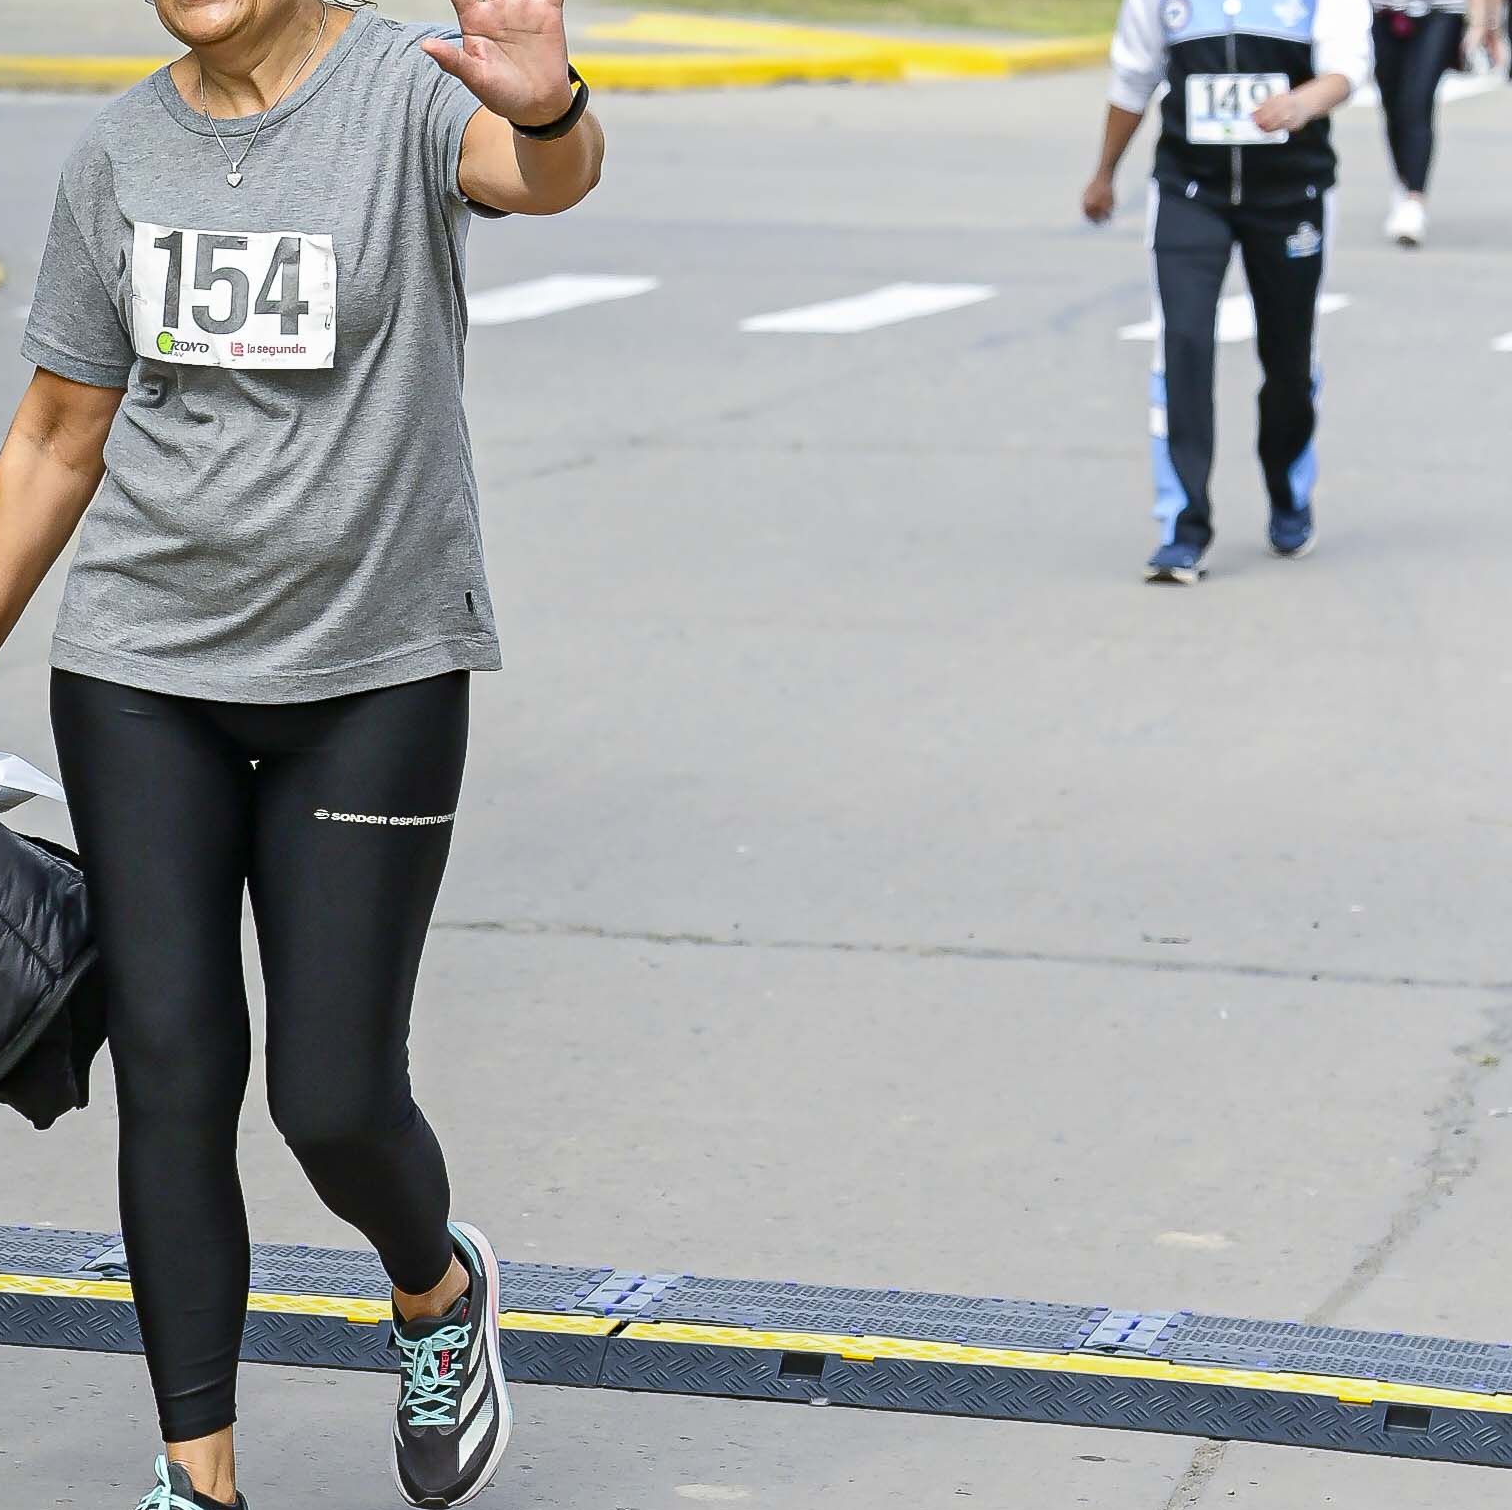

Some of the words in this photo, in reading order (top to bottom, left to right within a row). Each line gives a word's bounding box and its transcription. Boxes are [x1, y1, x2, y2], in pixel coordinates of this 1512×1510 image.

[154, 230, 309, 335] 154
[247, 343, 256, 354] la
[257, 344, 307, 356] segunda
[439, 1350, 449, 1377] DIZER
